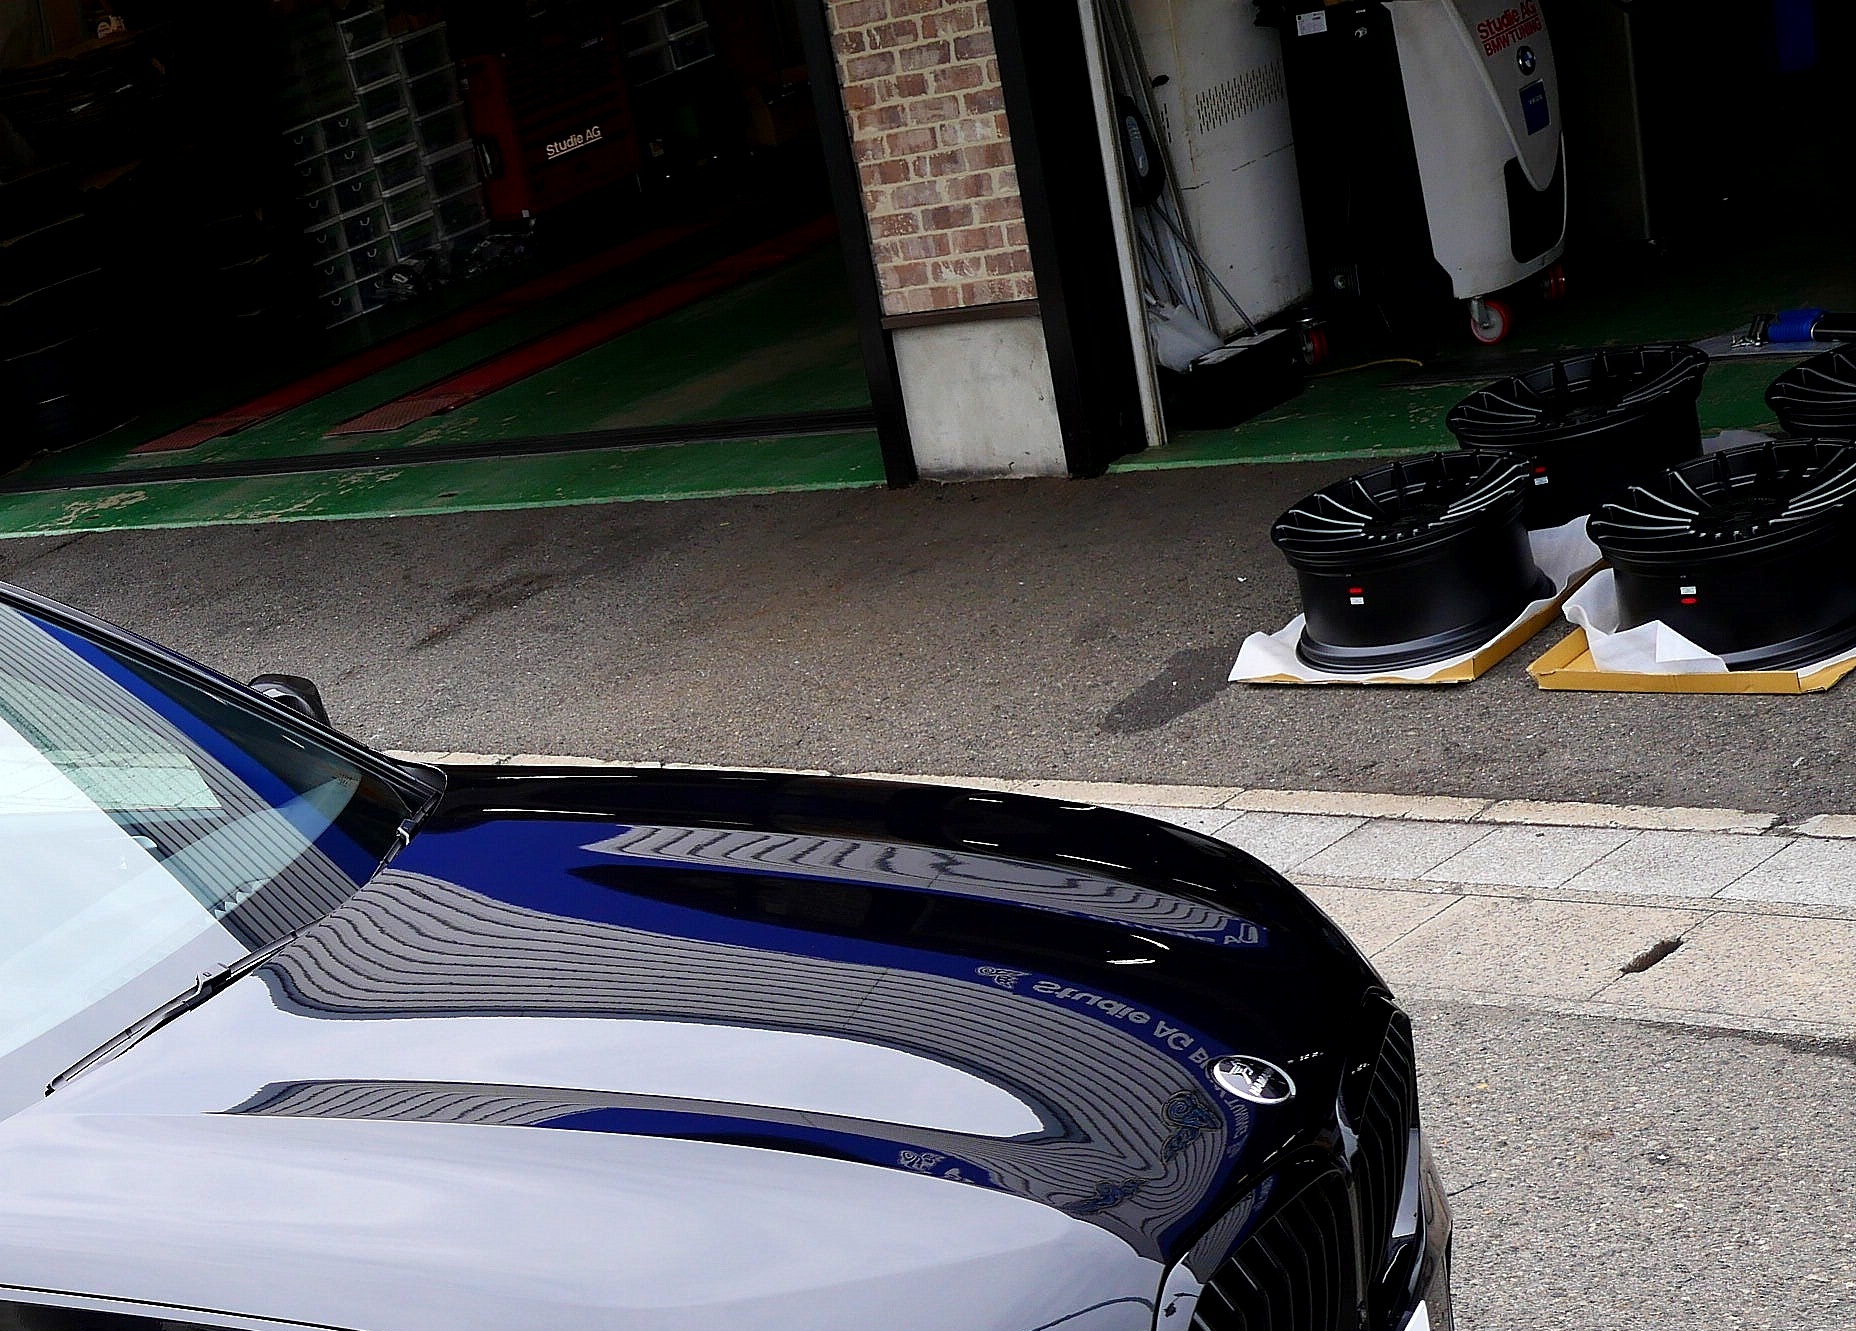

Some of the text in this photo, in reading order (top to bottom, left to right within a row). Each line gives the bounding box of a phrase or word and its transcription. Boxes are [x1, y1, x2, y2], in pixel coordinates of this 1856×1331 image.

[1476, 8, 1521, 40] Studie
[546, 125, 601, 156] Studie AG
